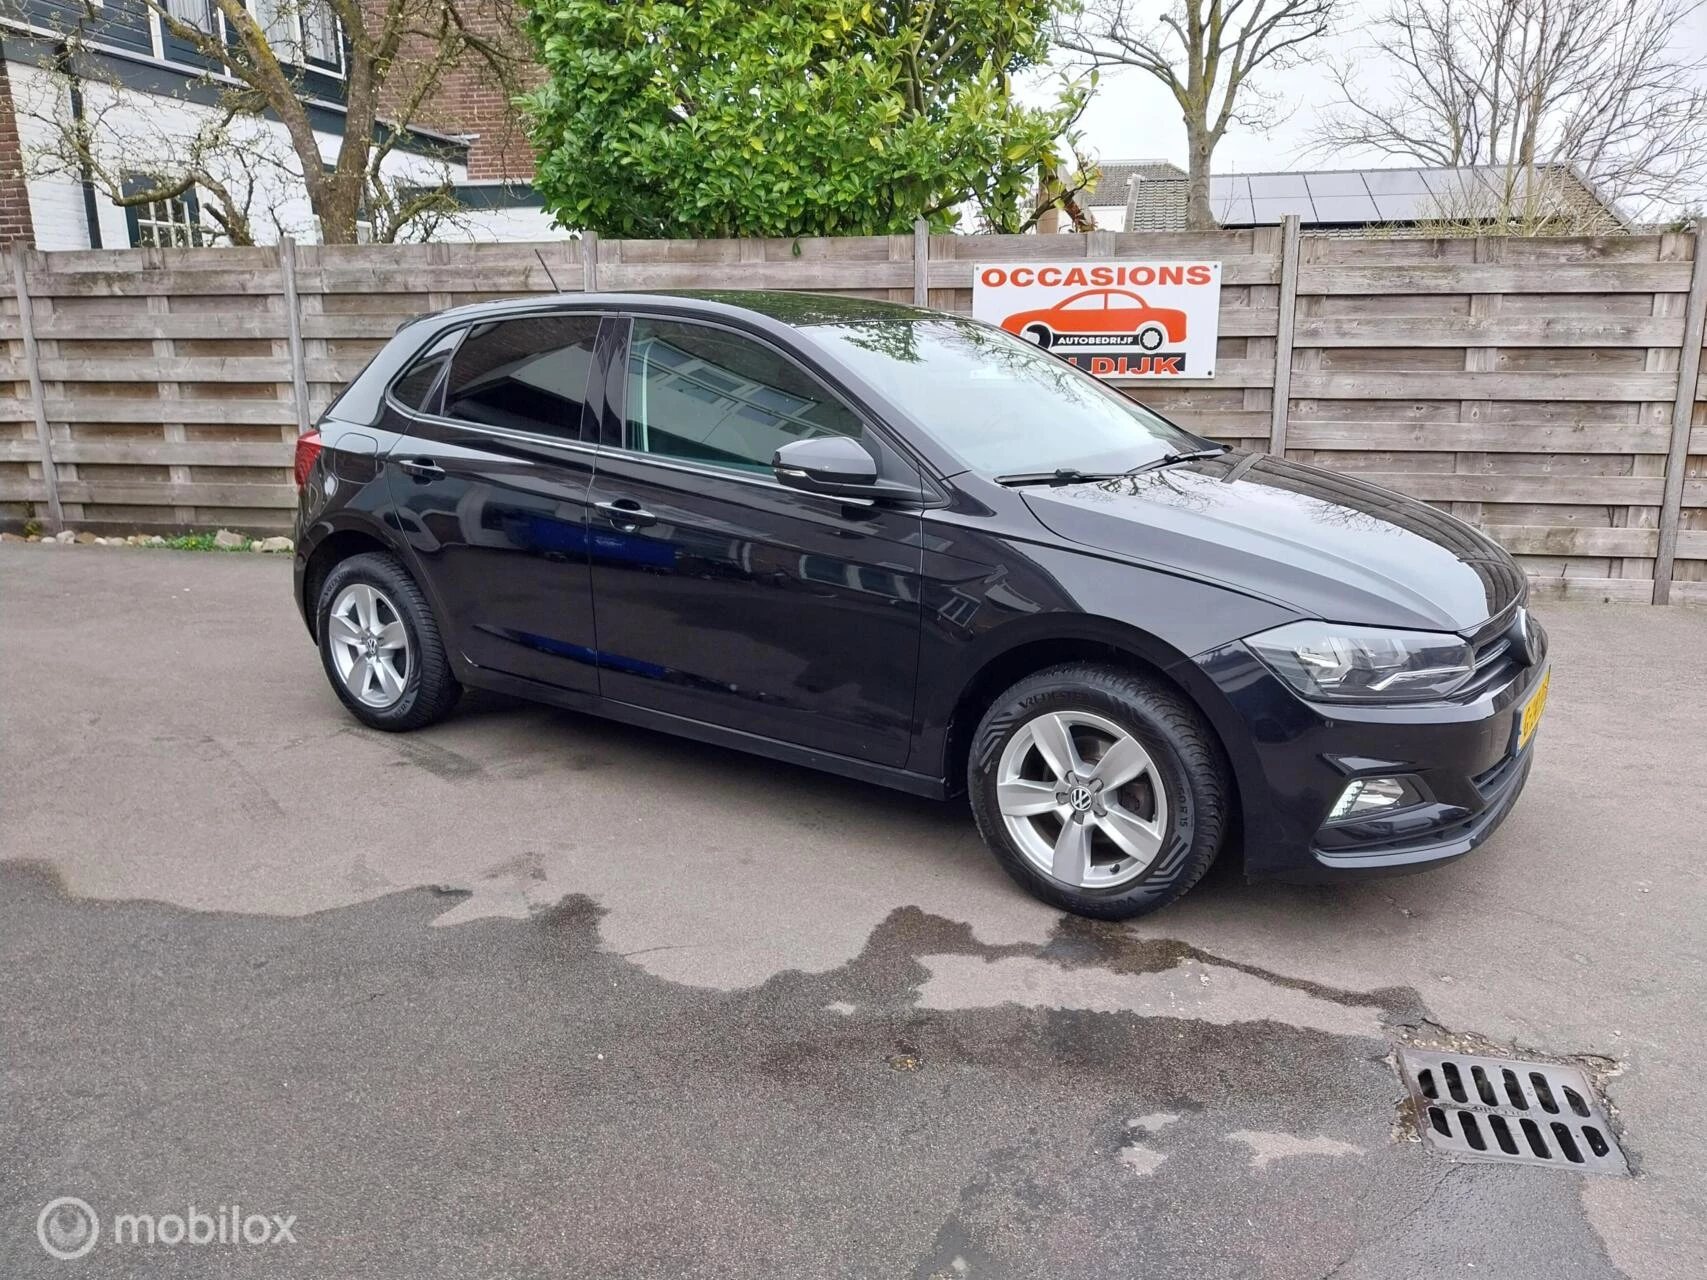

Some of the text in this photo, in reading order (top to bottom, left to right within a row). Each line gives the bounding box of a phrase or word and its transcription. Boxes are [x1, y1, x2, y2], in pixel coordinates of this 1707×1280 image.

[981, 265, 1211, 287] OCCASIONS
[1057, 336, 1134, 345] AUTOBEDRIJF
[1091, 356, 1183, 375] DIJK
